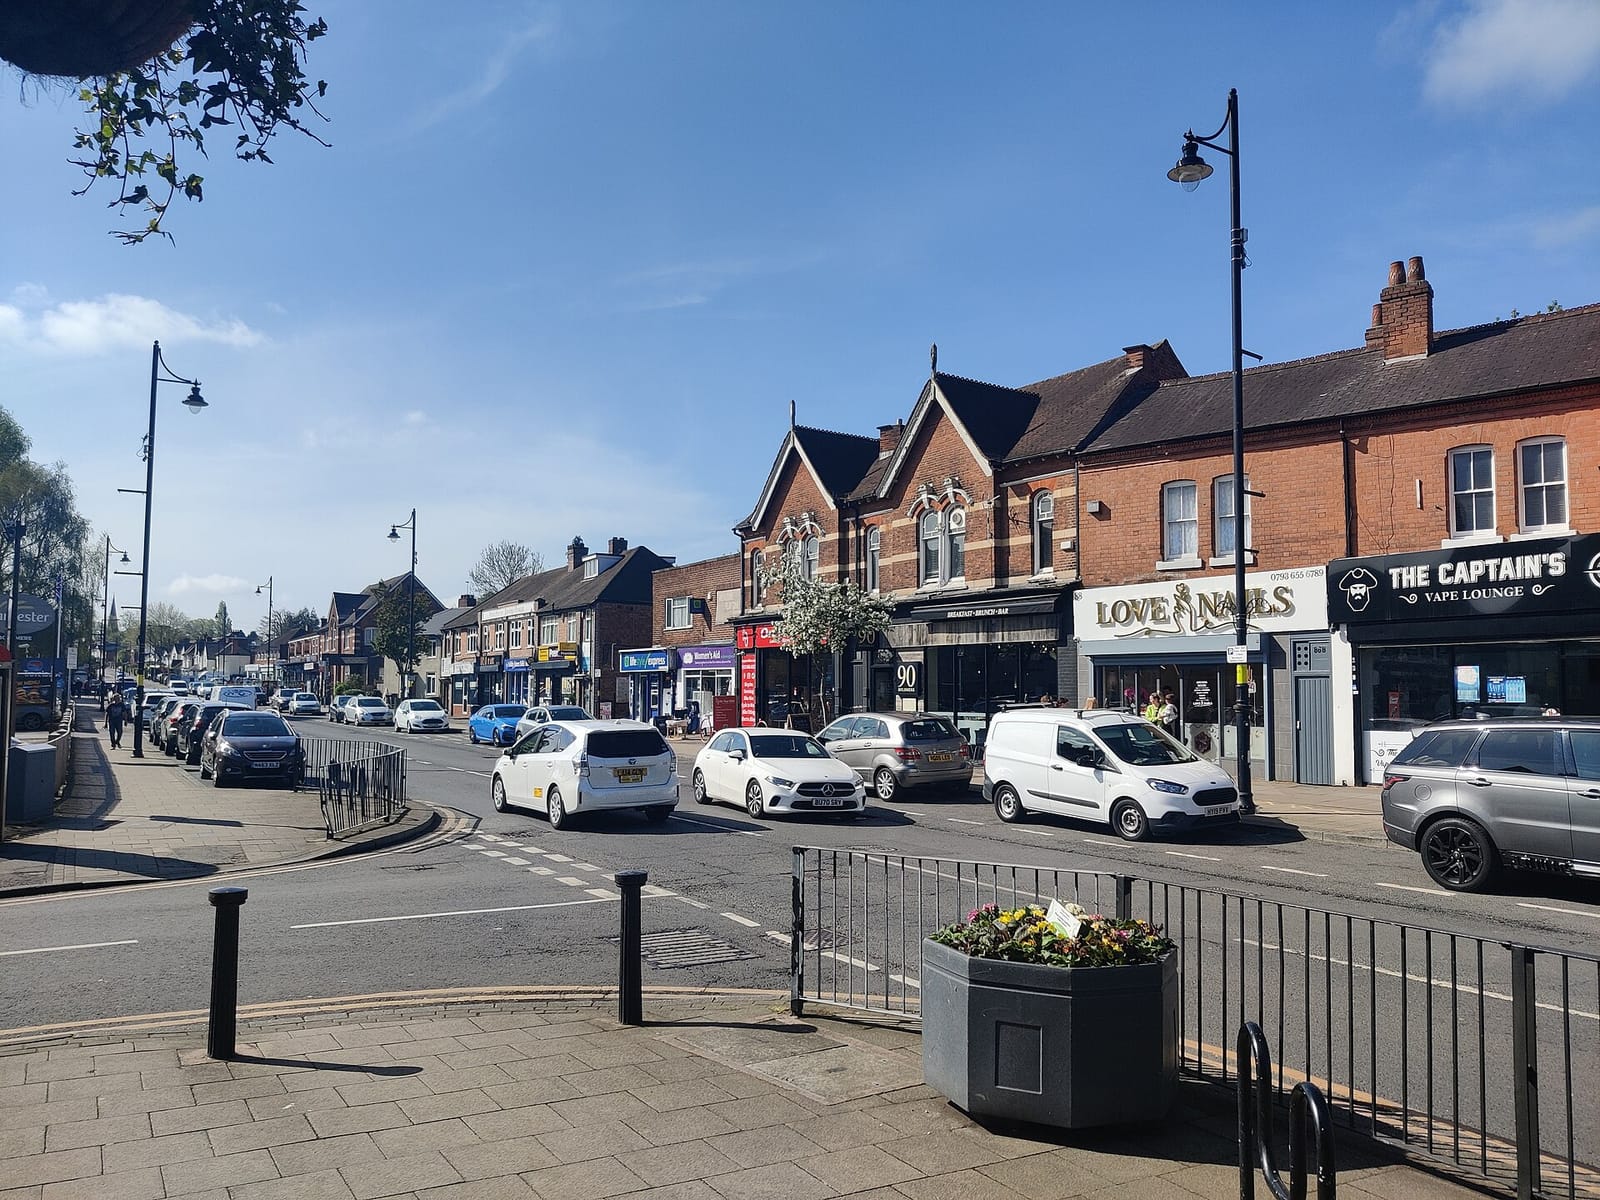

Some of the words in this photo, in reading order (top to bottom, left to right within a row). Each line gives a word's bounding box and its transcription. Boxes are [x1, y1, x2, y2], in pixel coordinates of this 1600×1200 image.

[1270, 573, 1289, 581] 0793
[1305, 569, 1324, 578] 6789
[1388, 564, 1430, 590] THE
[1438, 551, 1566, 586] CAPTAIN'S
[1425, 590, 1459, 602] VAPE
[1462, 586, 1524, 600] LOUNGE
[1096, 596, 1169, 626] LOVE
[1197, 586, 1294, 617] NAILS
[897, 664, 916, 687] 90
